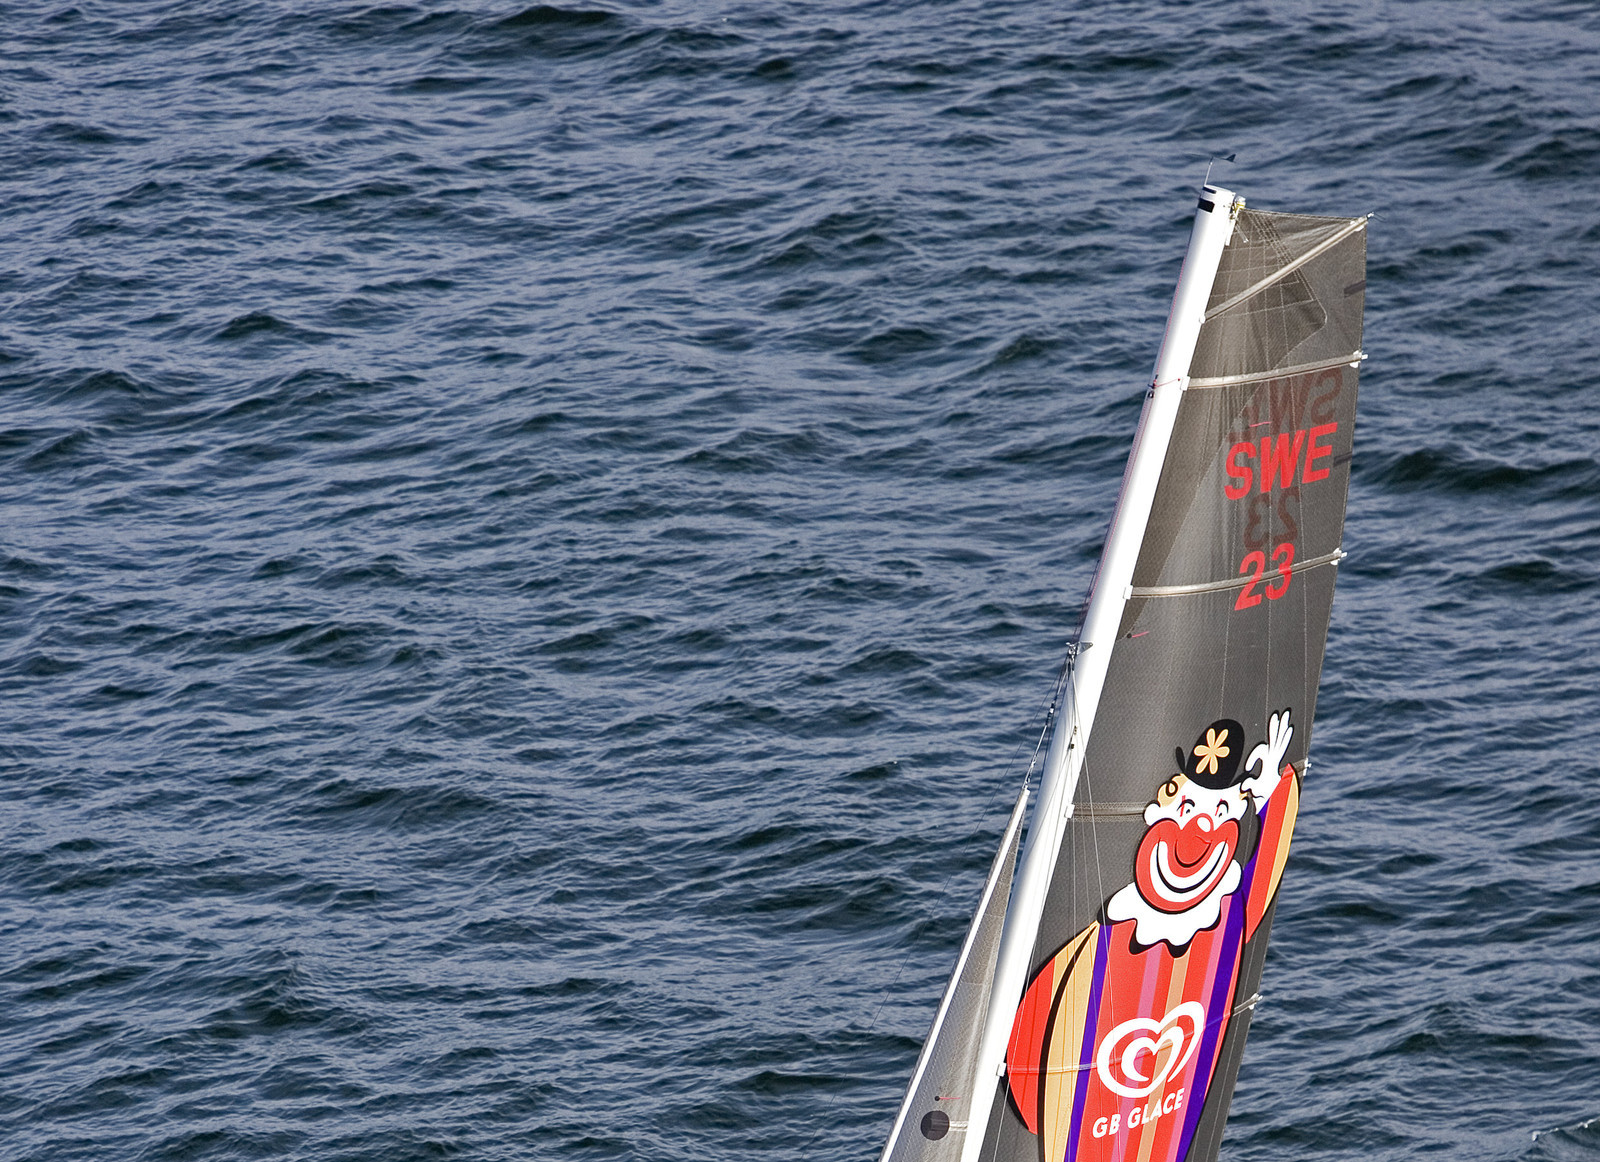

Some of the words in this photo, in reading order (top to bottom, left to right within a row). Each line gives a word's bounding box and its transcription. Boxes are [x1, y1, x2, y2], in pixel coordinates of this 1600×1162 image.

[1224, 422, 1338, 500] SWE
[1234, 543, 1295, 611] 23
[1092, 1114, 1121, 1138] GB
[1127, 1088, 1185, 1129] GLACE
